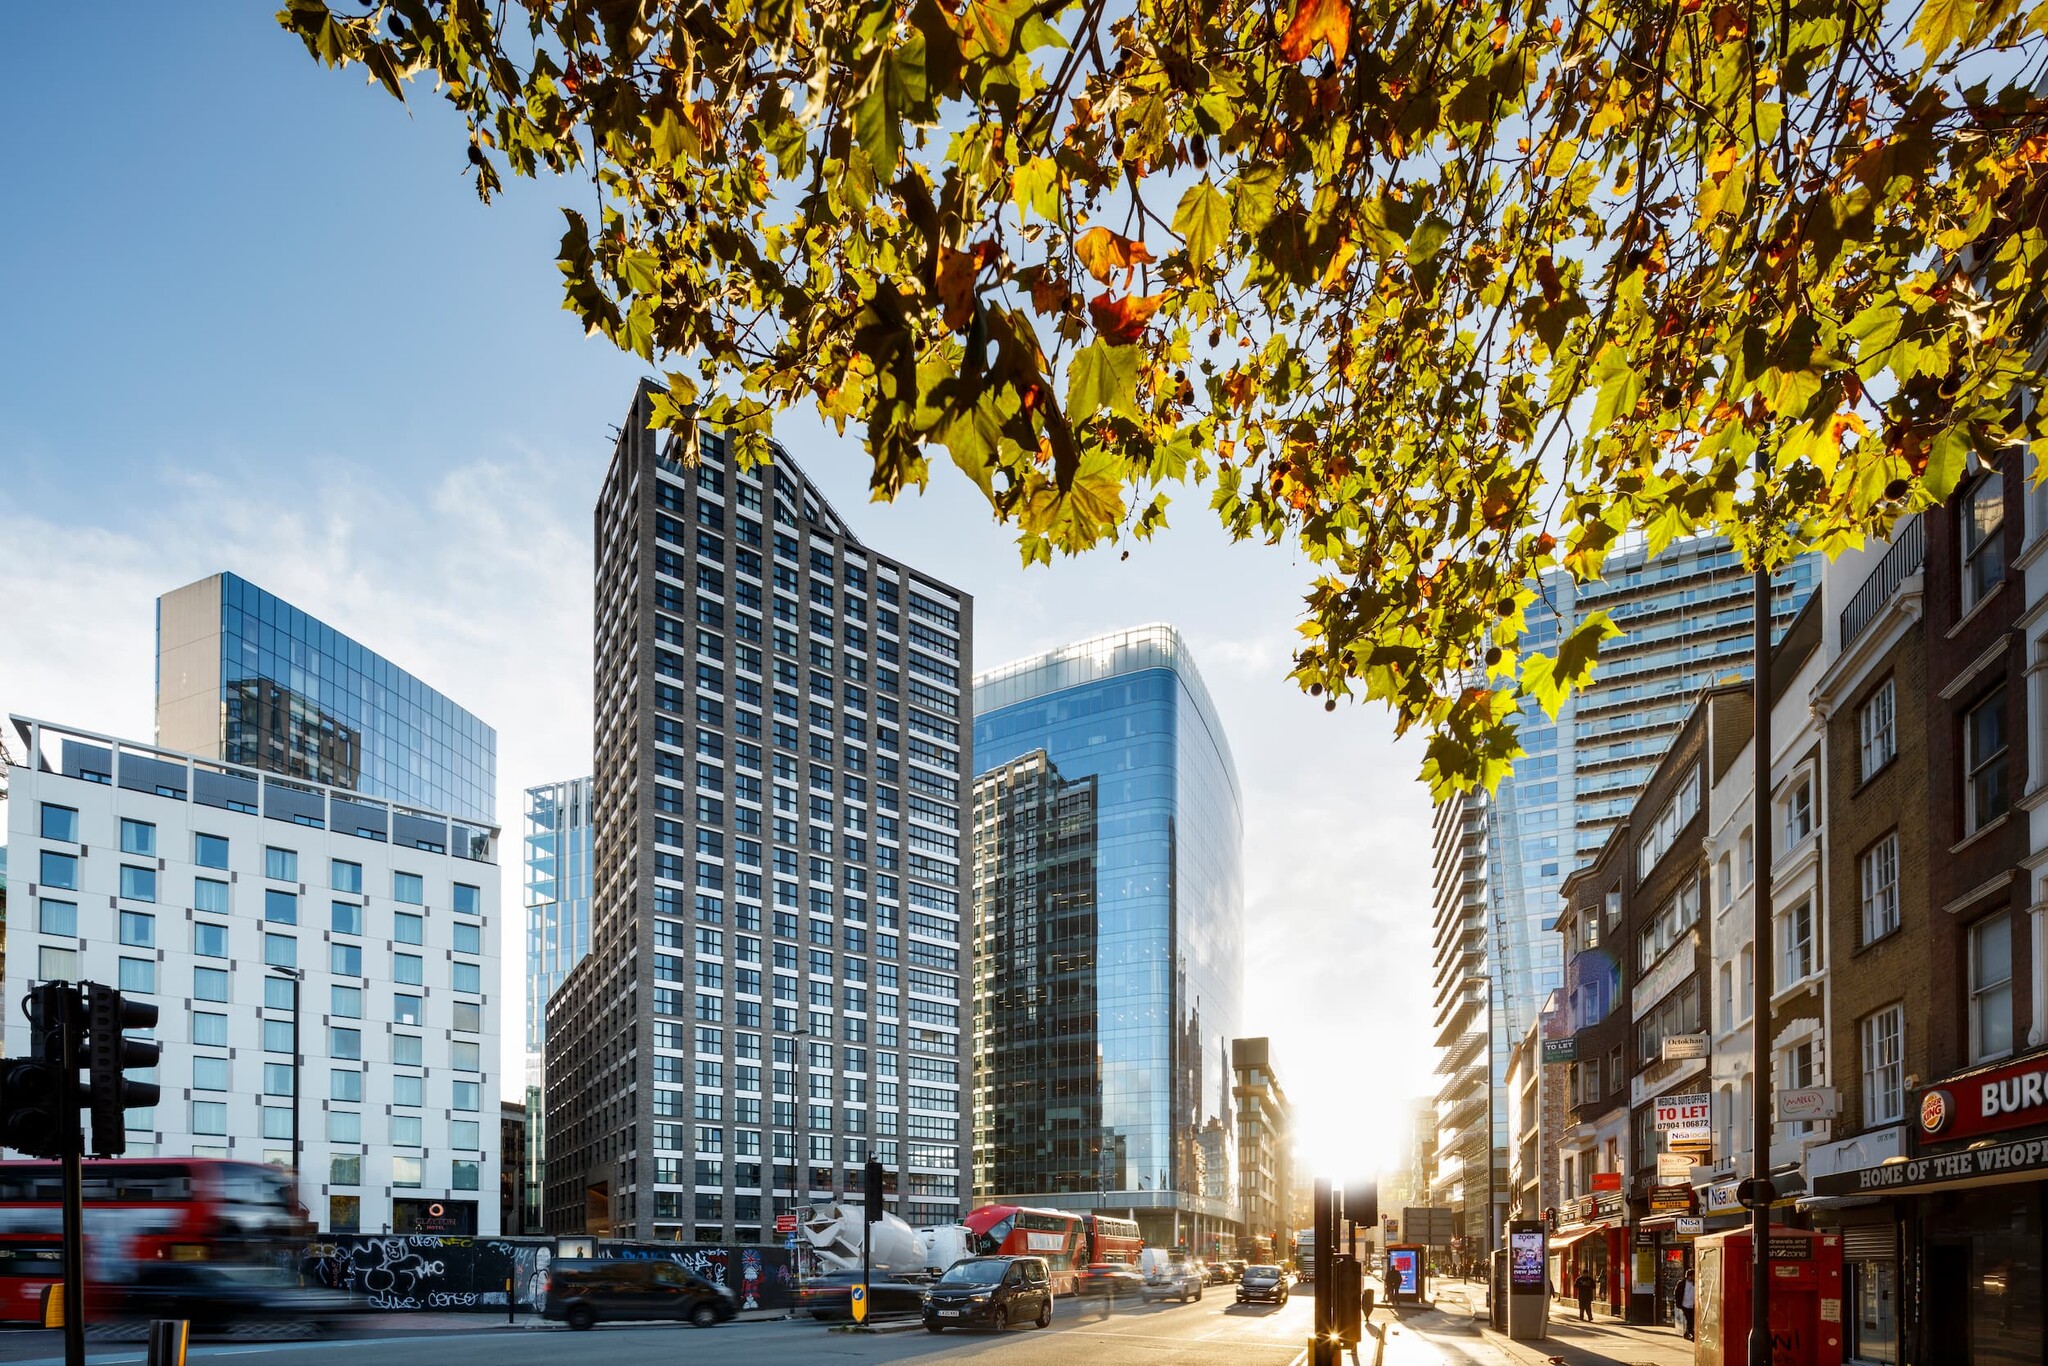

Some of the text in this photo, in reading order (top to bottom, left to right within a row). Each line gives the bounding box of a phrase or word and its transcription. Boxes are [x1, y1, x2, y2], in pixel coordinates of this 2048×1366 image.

[1658, 1096, 1677, 1106] MEDICAL
[1981, 1071, 2048, 1117] BUR
[1657, 1105, 1708, 1120] TO LET
[1923, 1104, 1942, 1121] KING
[1657, 1119, 1708, 1130] 07904 106872
[1859, 1166, 1903, 1188] HOME
[1906, 1160, 1930, 1181] OF
[1933, 1153, 1972, 1177] THE
[1711, 1184, 1738, 1207] Nisa loc
[1680, 1218, 1700, 1226] Nisa
[1527, 1268, 1541, 1276] job?
